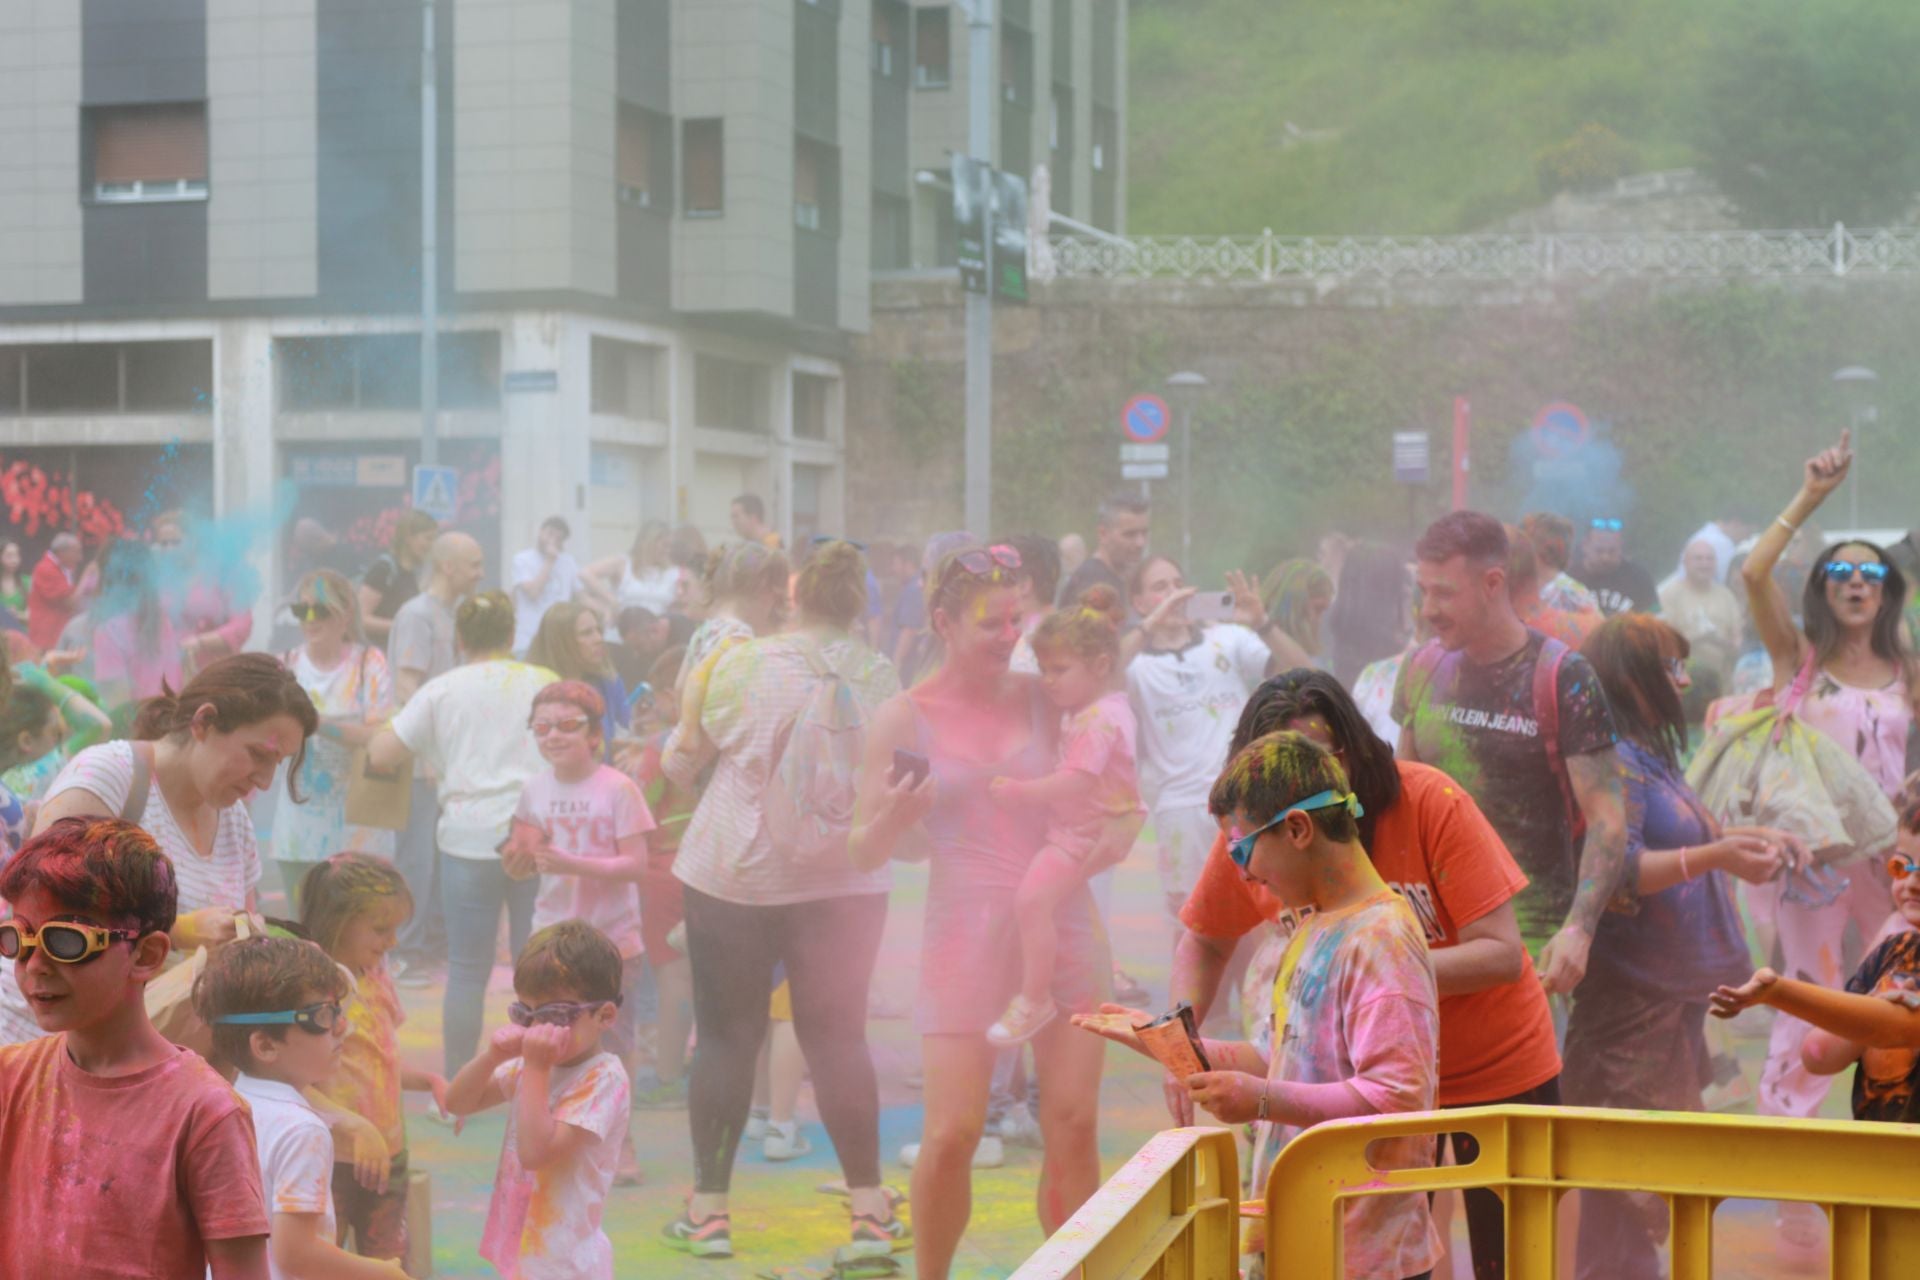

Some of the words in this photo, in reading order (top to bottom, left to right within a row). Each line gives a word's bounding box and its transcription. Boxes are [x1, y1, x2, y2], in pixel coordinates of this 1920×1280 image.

[1451, 707, 1489, 727] KLEIN
[1488, 713, 1538, 737] JEANS
[549, 800, 590, 814] TEAM
